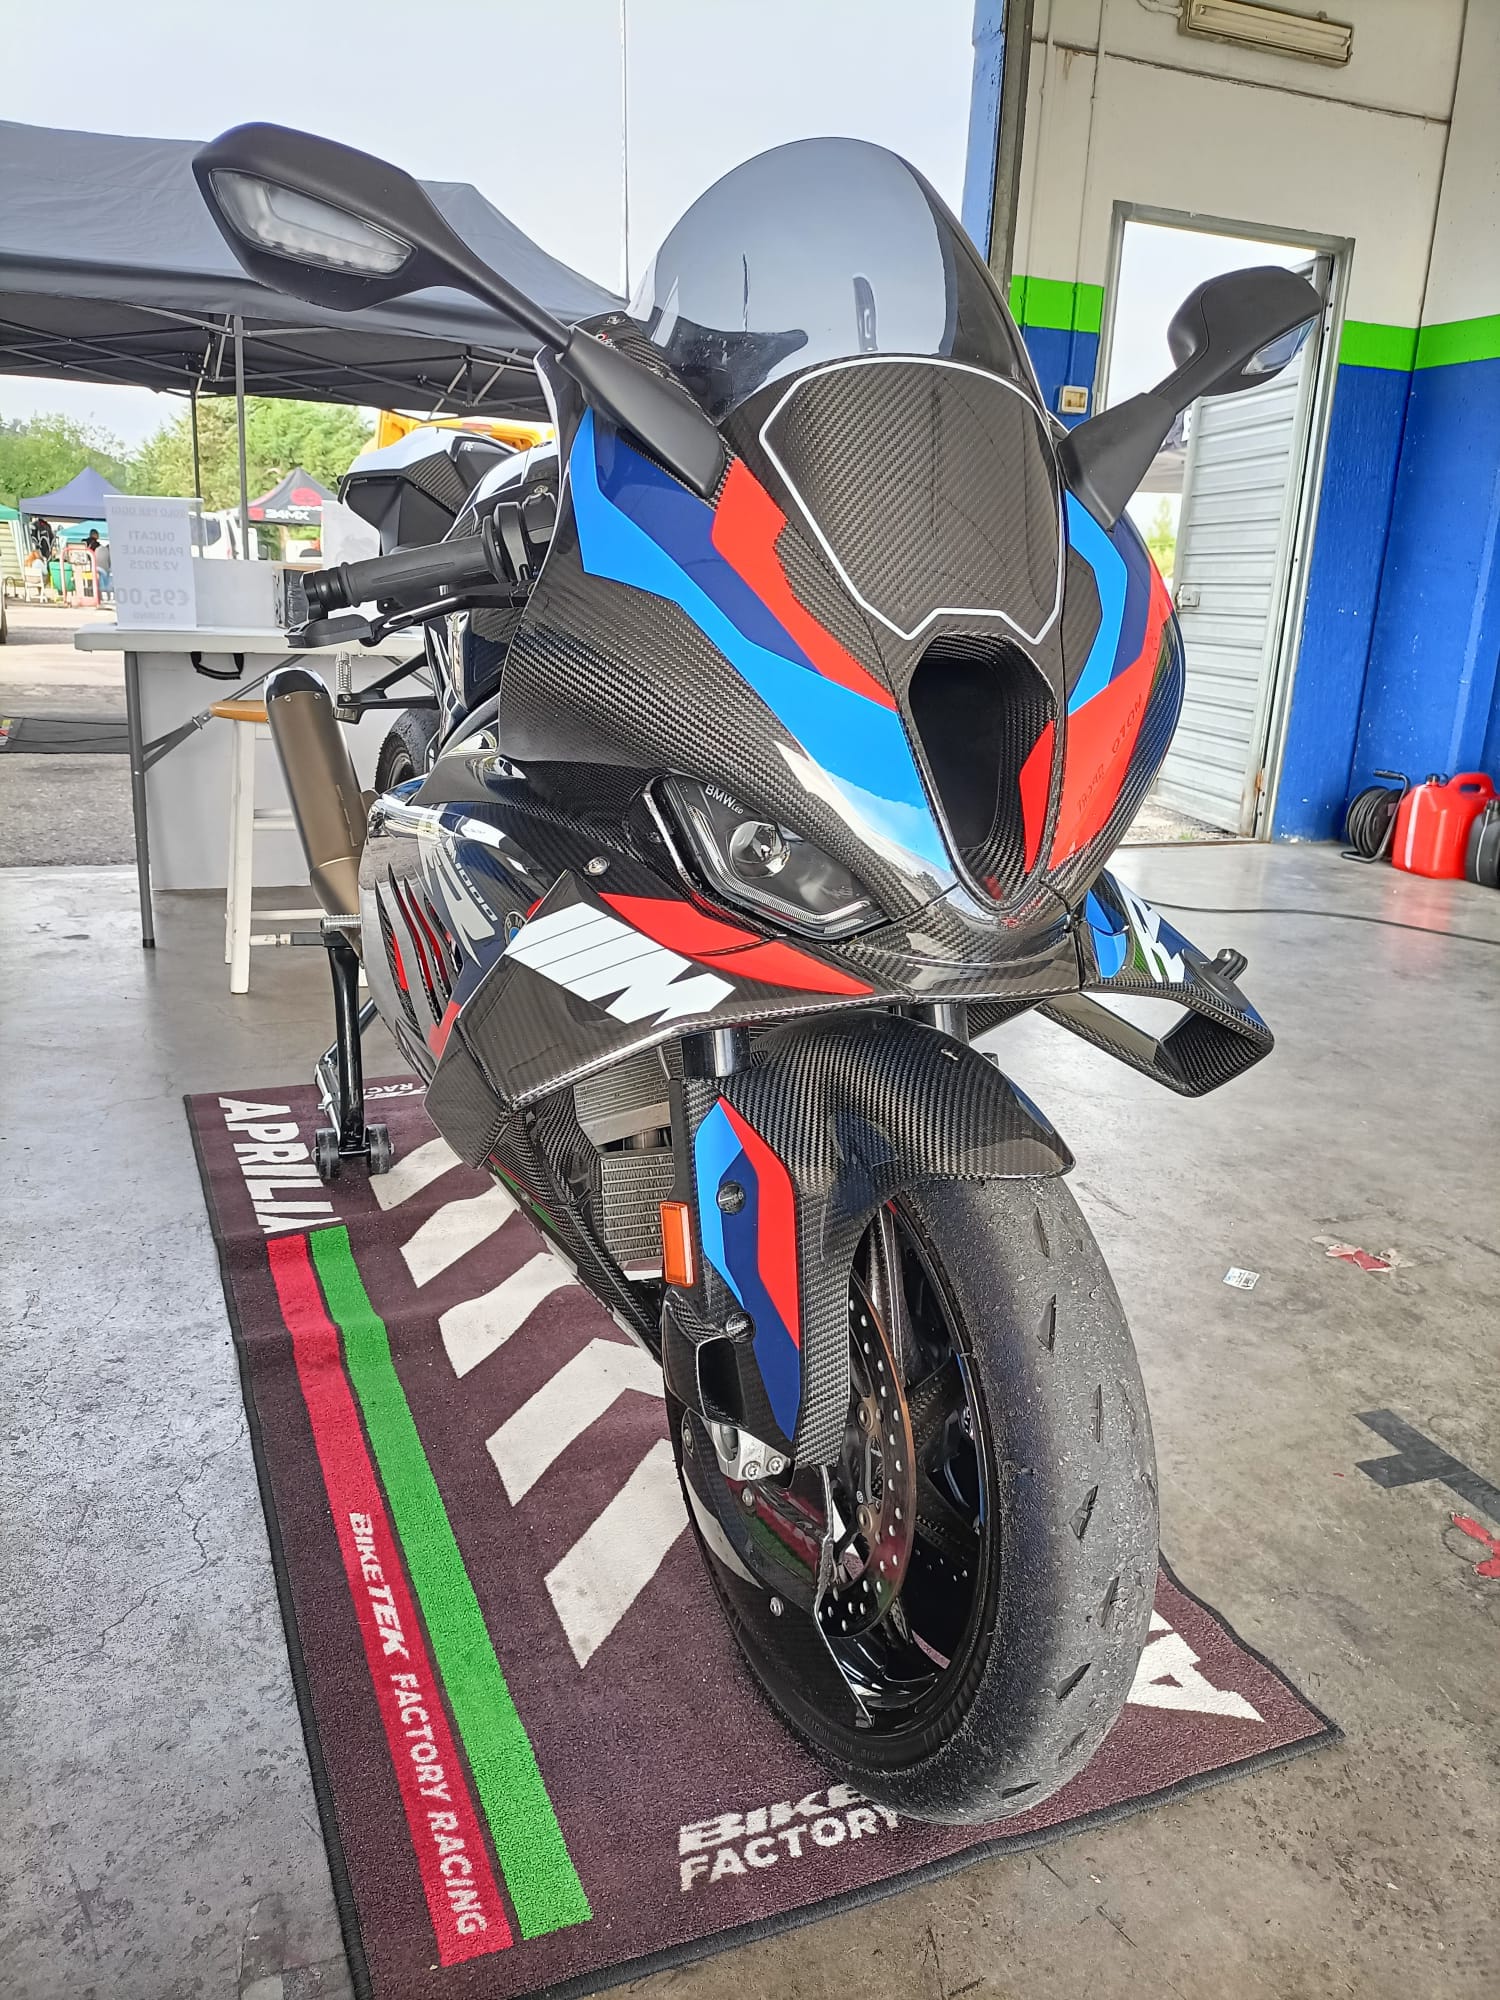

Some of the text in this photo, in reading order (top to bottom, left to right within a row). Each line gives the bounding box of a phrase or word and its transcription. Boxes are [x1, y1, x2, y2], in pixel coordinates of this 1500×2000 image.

[705, 784, 744, 814] BMW LED
[455, 862, 498, 921] 1000
[218, 1096, 343, 1234] APRILIA
[391, 1673, 452, 1802] FACTORY
[428, 1811, 488, 1935] RACING
[679, 1783, 867, 1856] BIKE
